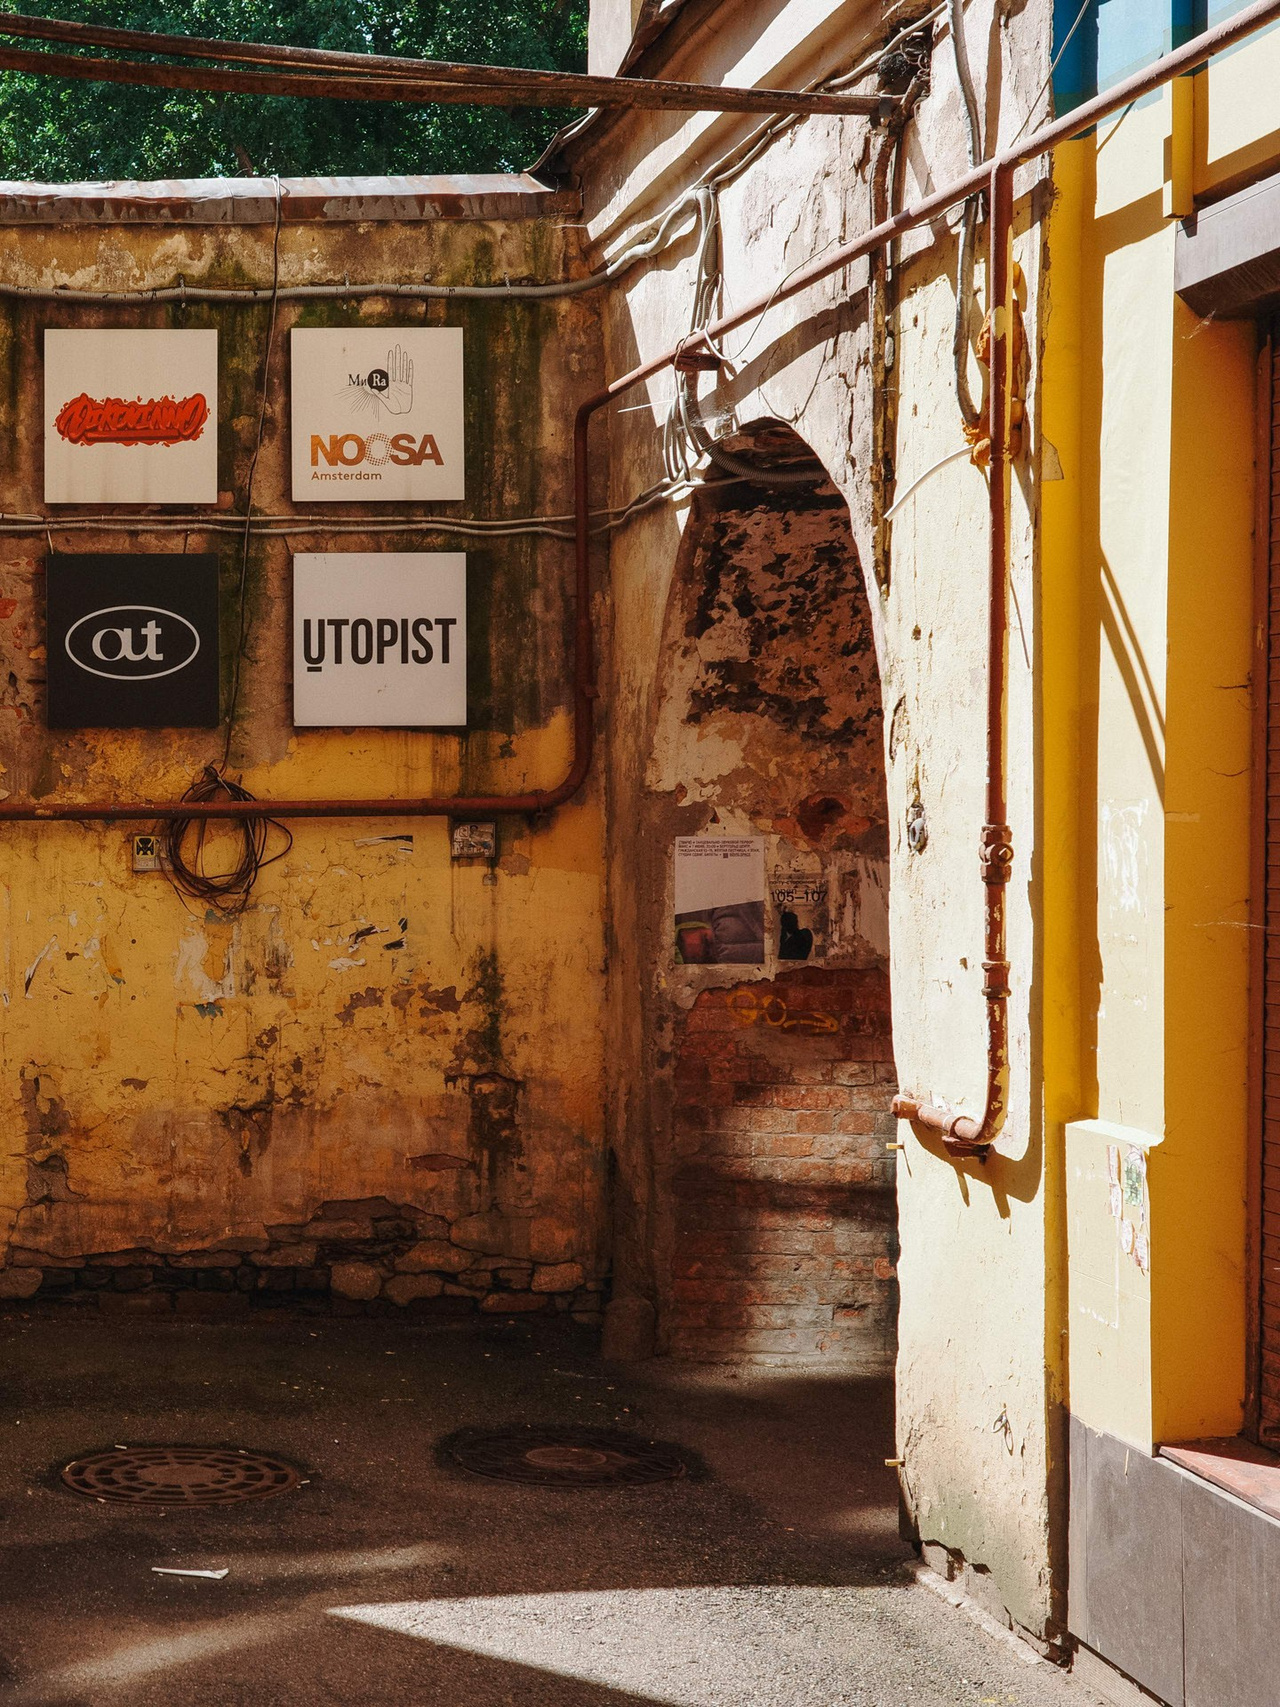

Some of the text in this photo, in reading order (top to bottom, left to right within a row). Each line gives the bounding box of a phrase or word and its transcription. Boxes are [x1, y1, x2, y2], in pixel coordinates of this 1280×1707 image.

[310, 432, 445, 467] NOOSA
[310, 470, 383, 481] Amsterdam
[303, 617, 457, 672] UTOPIST
